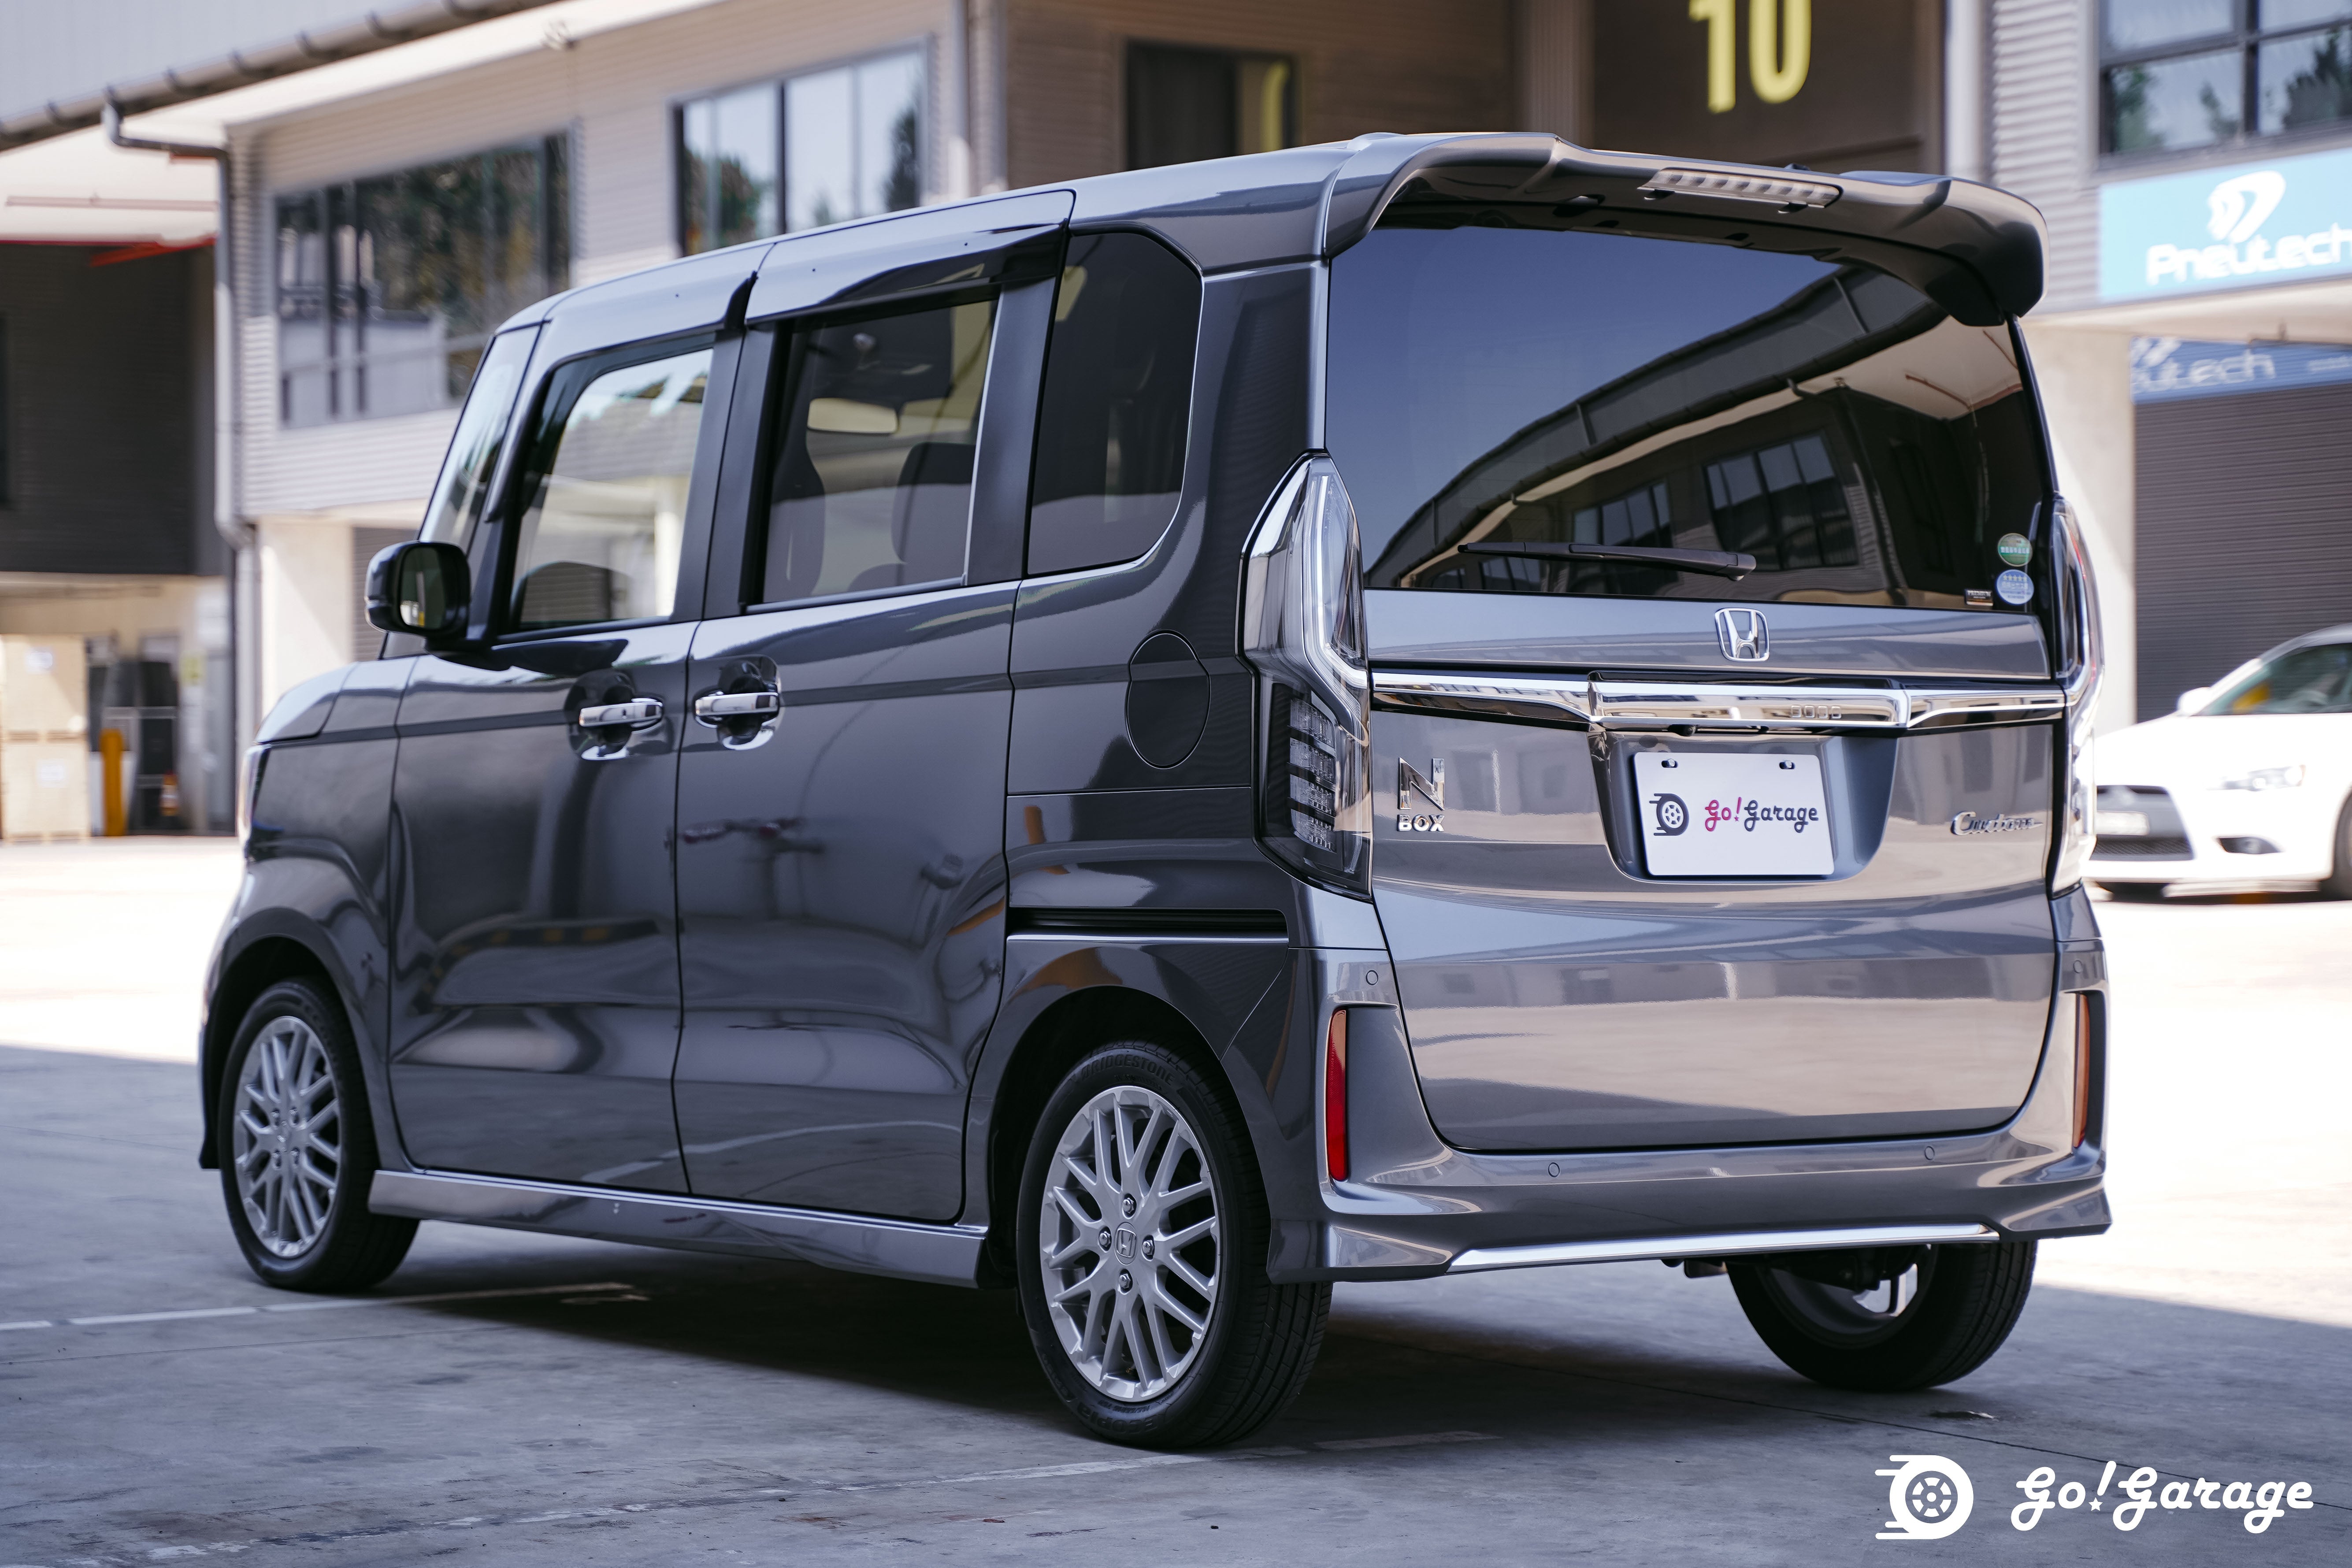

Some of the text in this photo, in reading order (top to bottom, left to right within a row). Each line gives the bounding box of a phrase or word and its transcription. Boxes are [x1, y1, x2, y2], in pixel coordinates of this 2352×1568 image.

[1688, 0, 1811, 113] 10
[1398, 757, 1445, 810] N
[1397, 814, 1445, 832] BOX
[1081, 1054, 1176, 1086] BRIDGESTONE
